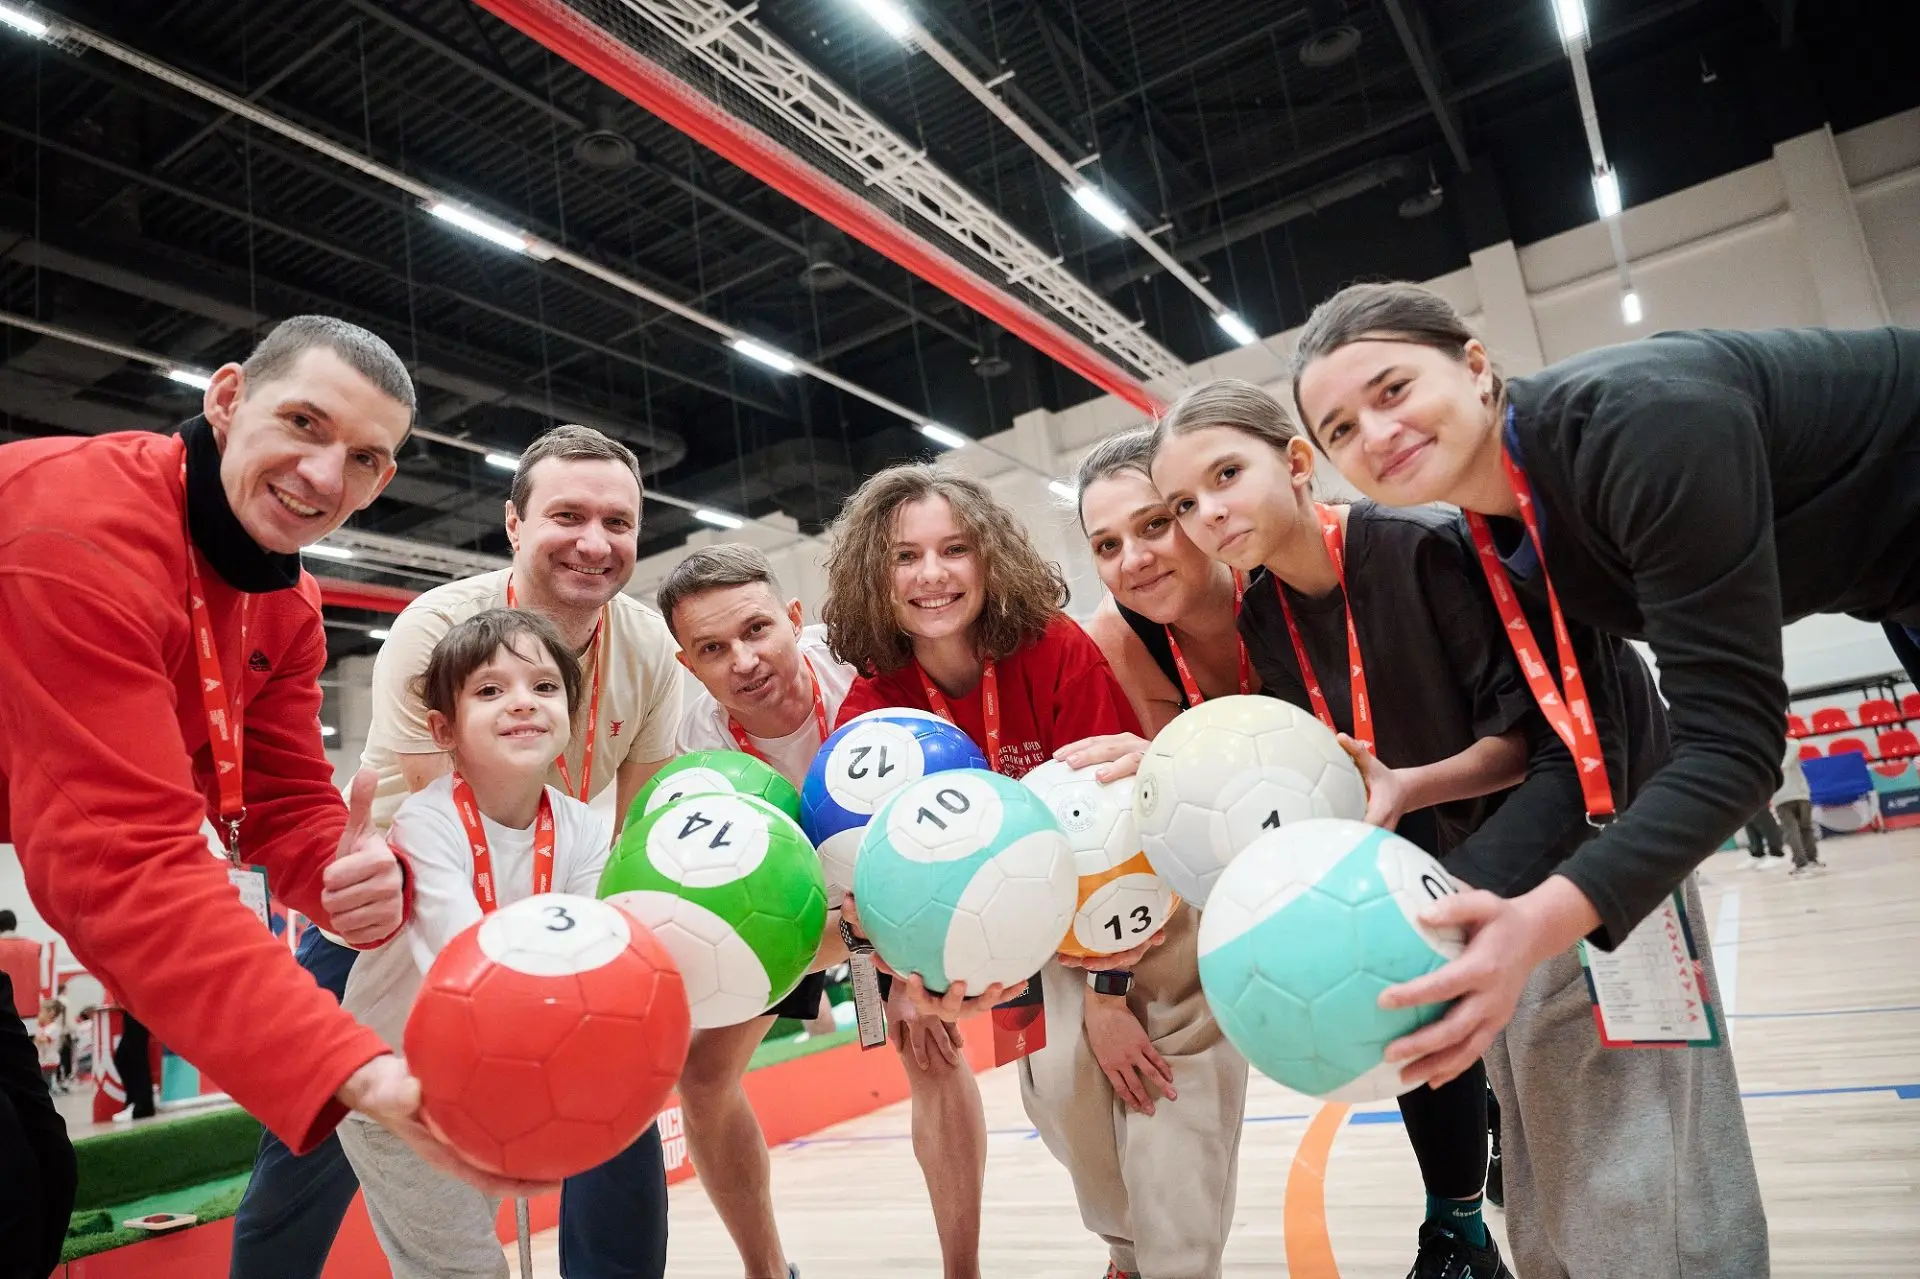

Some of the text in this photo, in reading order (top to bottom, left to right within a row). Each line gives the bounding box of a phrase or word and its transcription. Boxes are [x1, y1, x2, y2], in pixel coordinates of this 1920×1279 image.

[848, 745, 895, 779] 12
[916, 788, 970, 831] 10
[677, 811, 734, 850] 14
[542, 906, 576, 932] 3
[1104, 905, 1152, 940] 13
